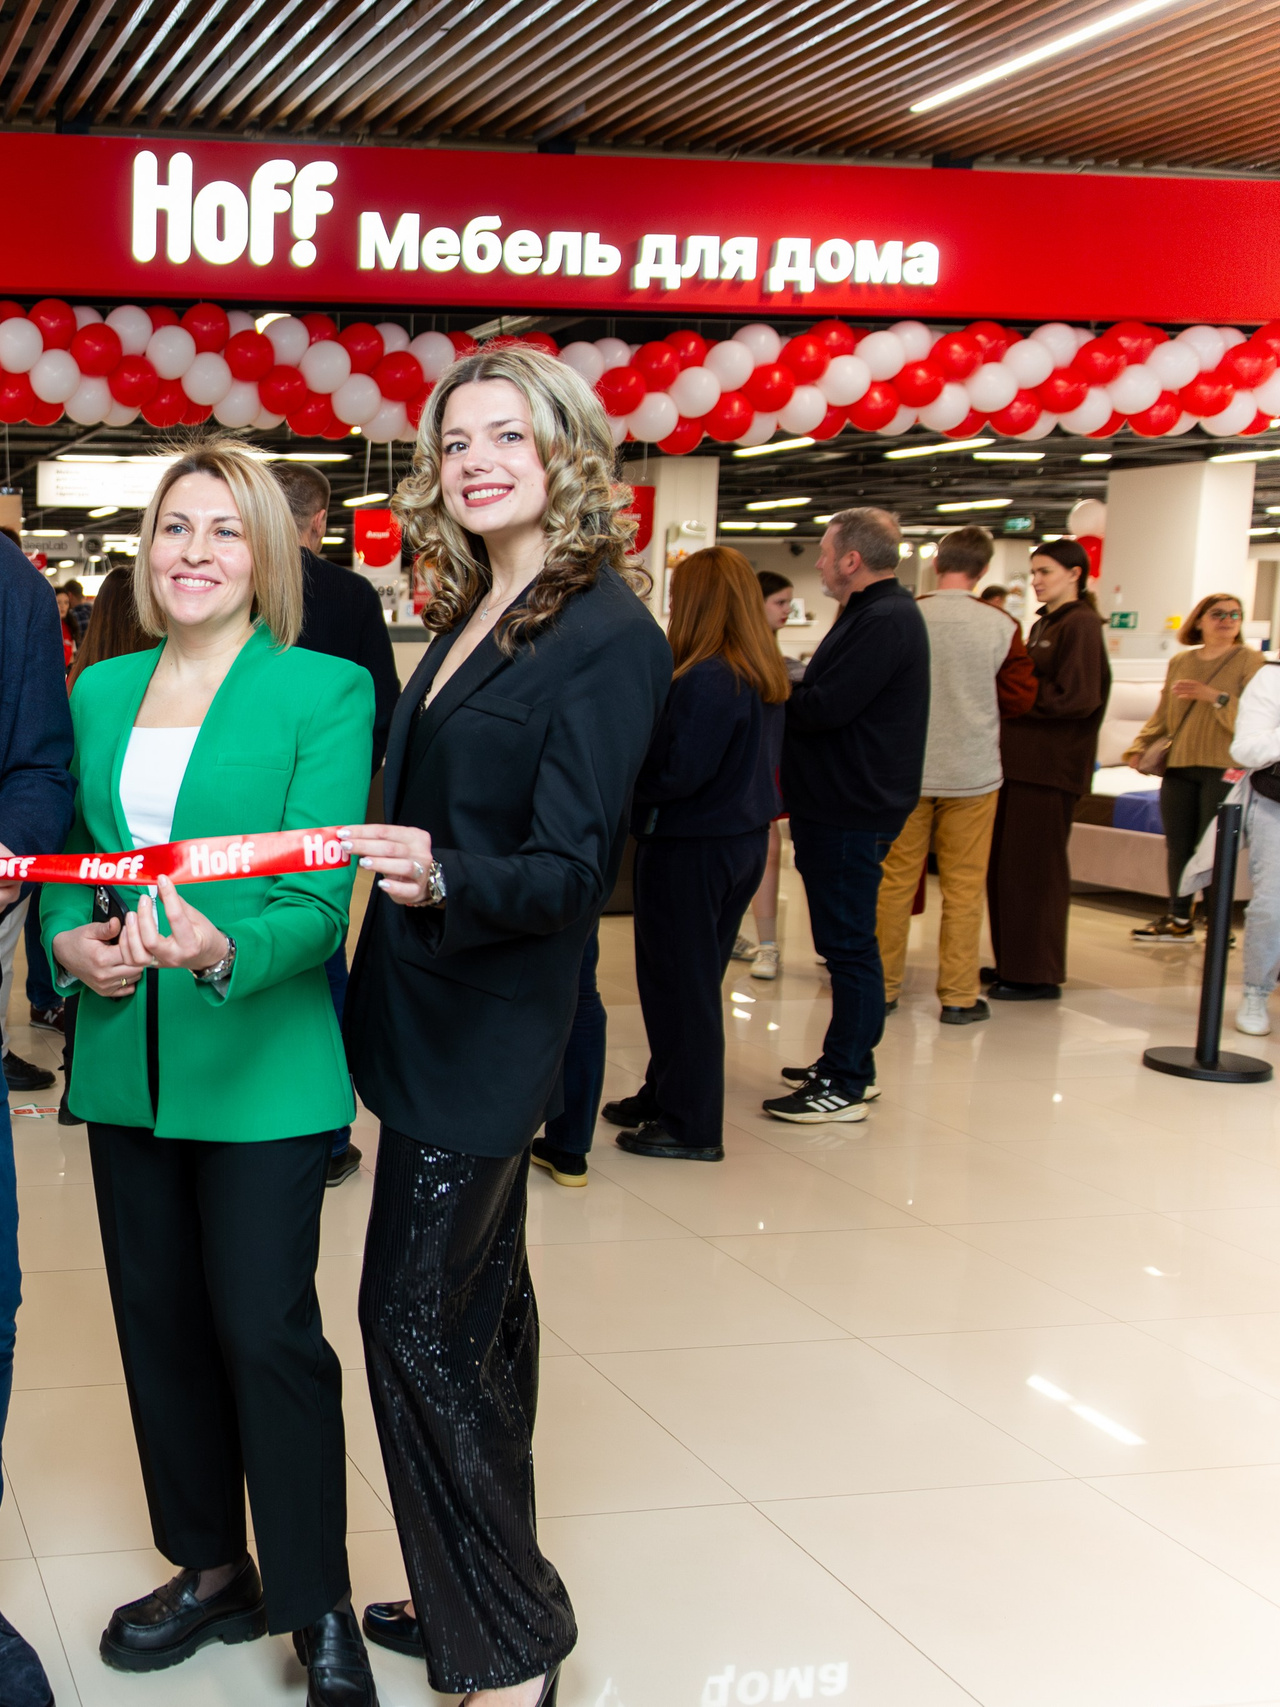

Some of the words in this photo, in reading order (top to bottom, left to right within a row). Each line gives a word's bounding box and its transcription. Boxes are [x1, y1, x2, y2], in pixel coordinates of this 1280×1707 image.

[358, 211, 622, 276] Мебель
[631, 233, 758, 290] для
[765, 237, 940, 293] дома
[79, 854, 144, 879] Hoff
[190, 842, 255, 877] Hoff
